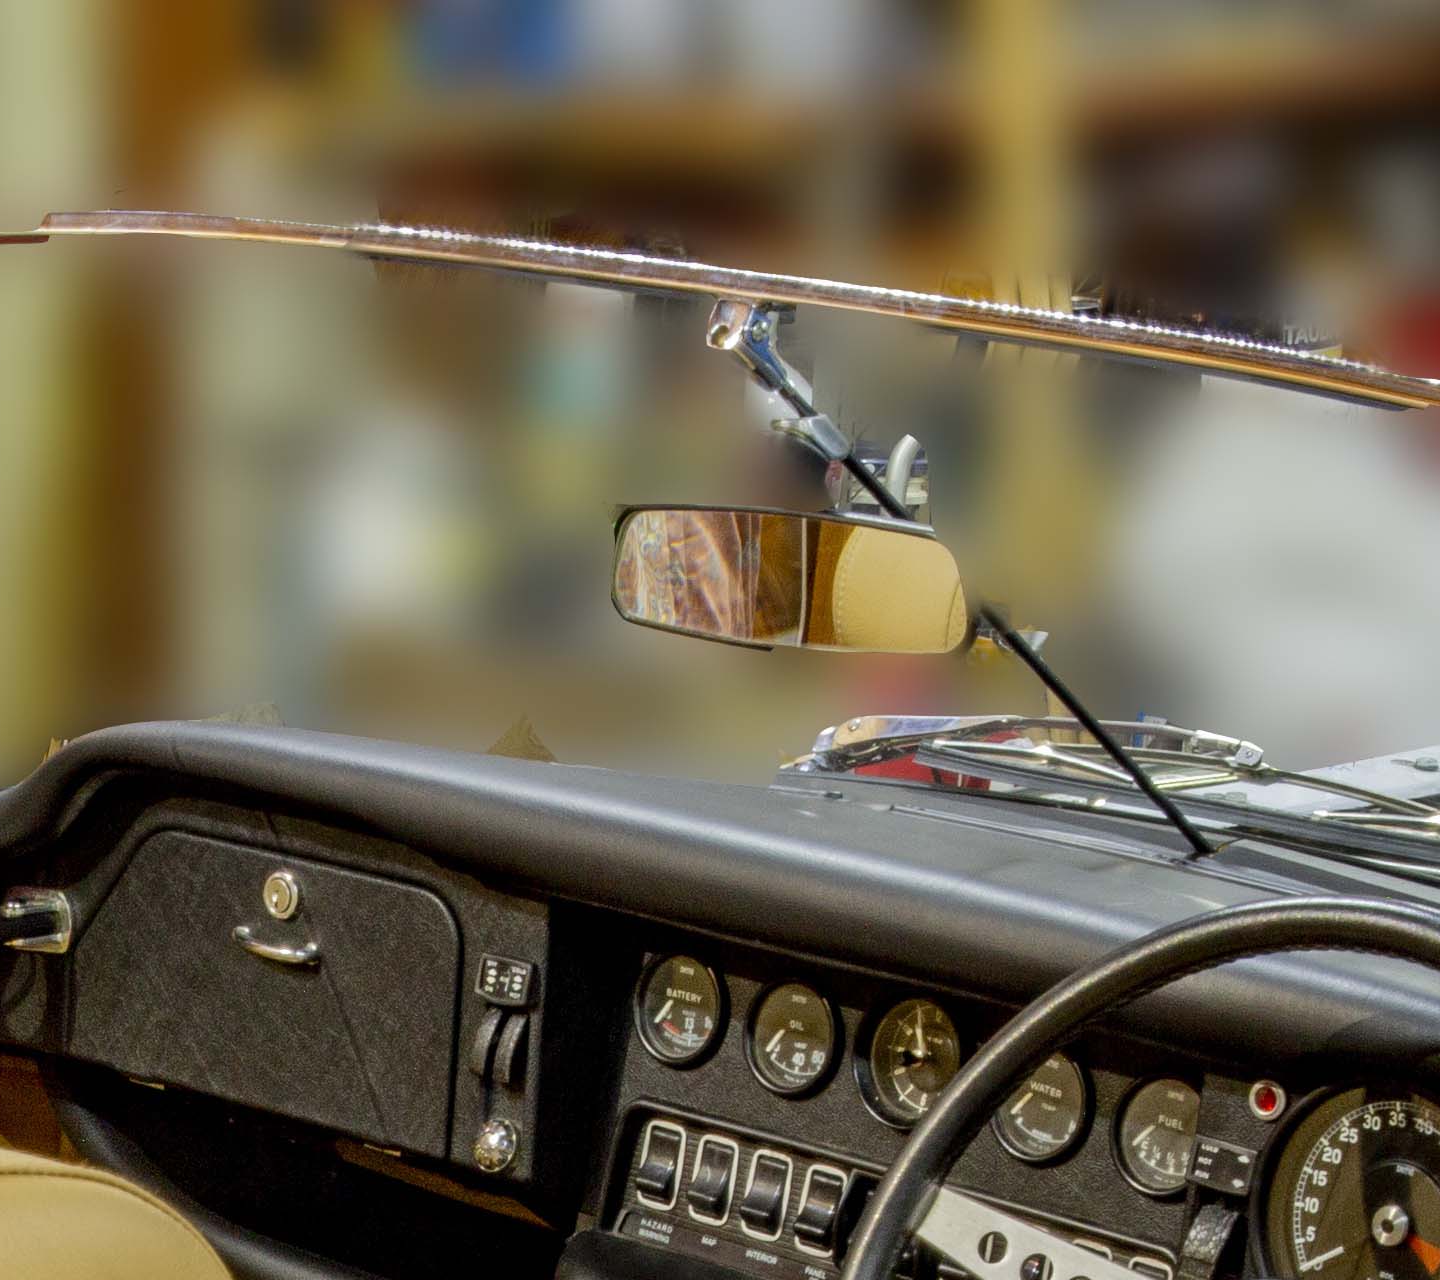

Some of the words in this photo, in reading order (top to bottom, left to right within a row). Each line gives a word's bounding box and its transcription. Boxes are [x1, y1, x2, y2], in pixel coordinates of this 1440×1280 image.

[666, 987, 702, 1004] BATTERY
[789, 1020, 804, 1031] OIL
[1030, 1080, 1063, 1100] WATER
[1158, 1114, 1185, 1130] FUEL
[1363, 1114, 1381, 1131] 30
[1389, 1111, 1406, 1128] 35
[1339, 1127, 1359, 1144] 25
[1322, 1146, 1342, 1165] 20
[1312, 1169, 1328, 1187] 15
[1304, 1196, 1320, 1214] 10
[640, 1217, 673, 1235] HAZARD
[1306, 1226, 1316, 1242] 5
[745, 1249, 778, 1265] INTERIOR
